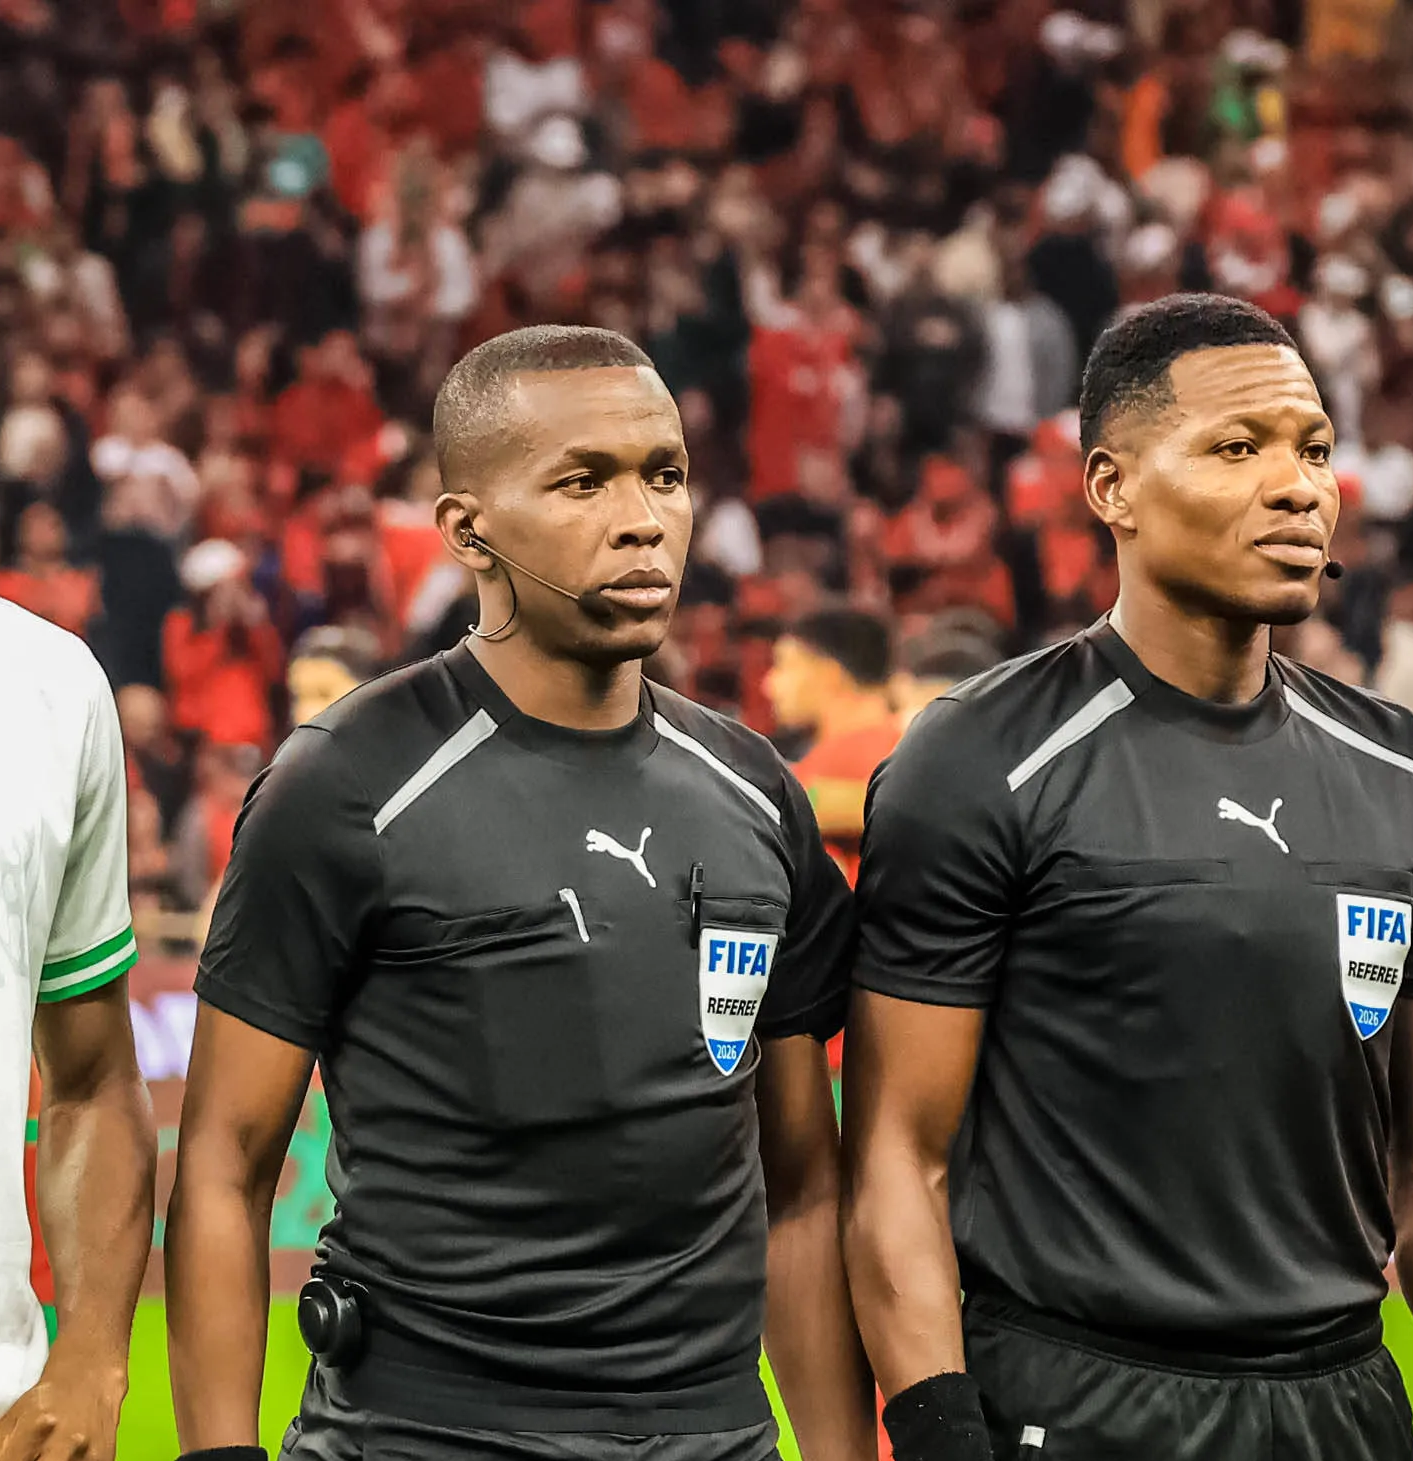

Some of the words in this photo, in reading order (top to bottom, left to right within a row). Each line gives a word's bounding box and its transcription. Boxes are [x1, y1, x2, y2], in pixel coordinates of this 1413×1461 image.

[1347, 905, 1407, 945] FIFA
[708, 939, 767, 976] FIFA
[1348, 960, 1398, 985] REFEREE
[707, 997, 757, 1016] REFEREE
[1358, 1008, 1379, 1026] 2026
[717, 1044, 737, 1060] 2026
